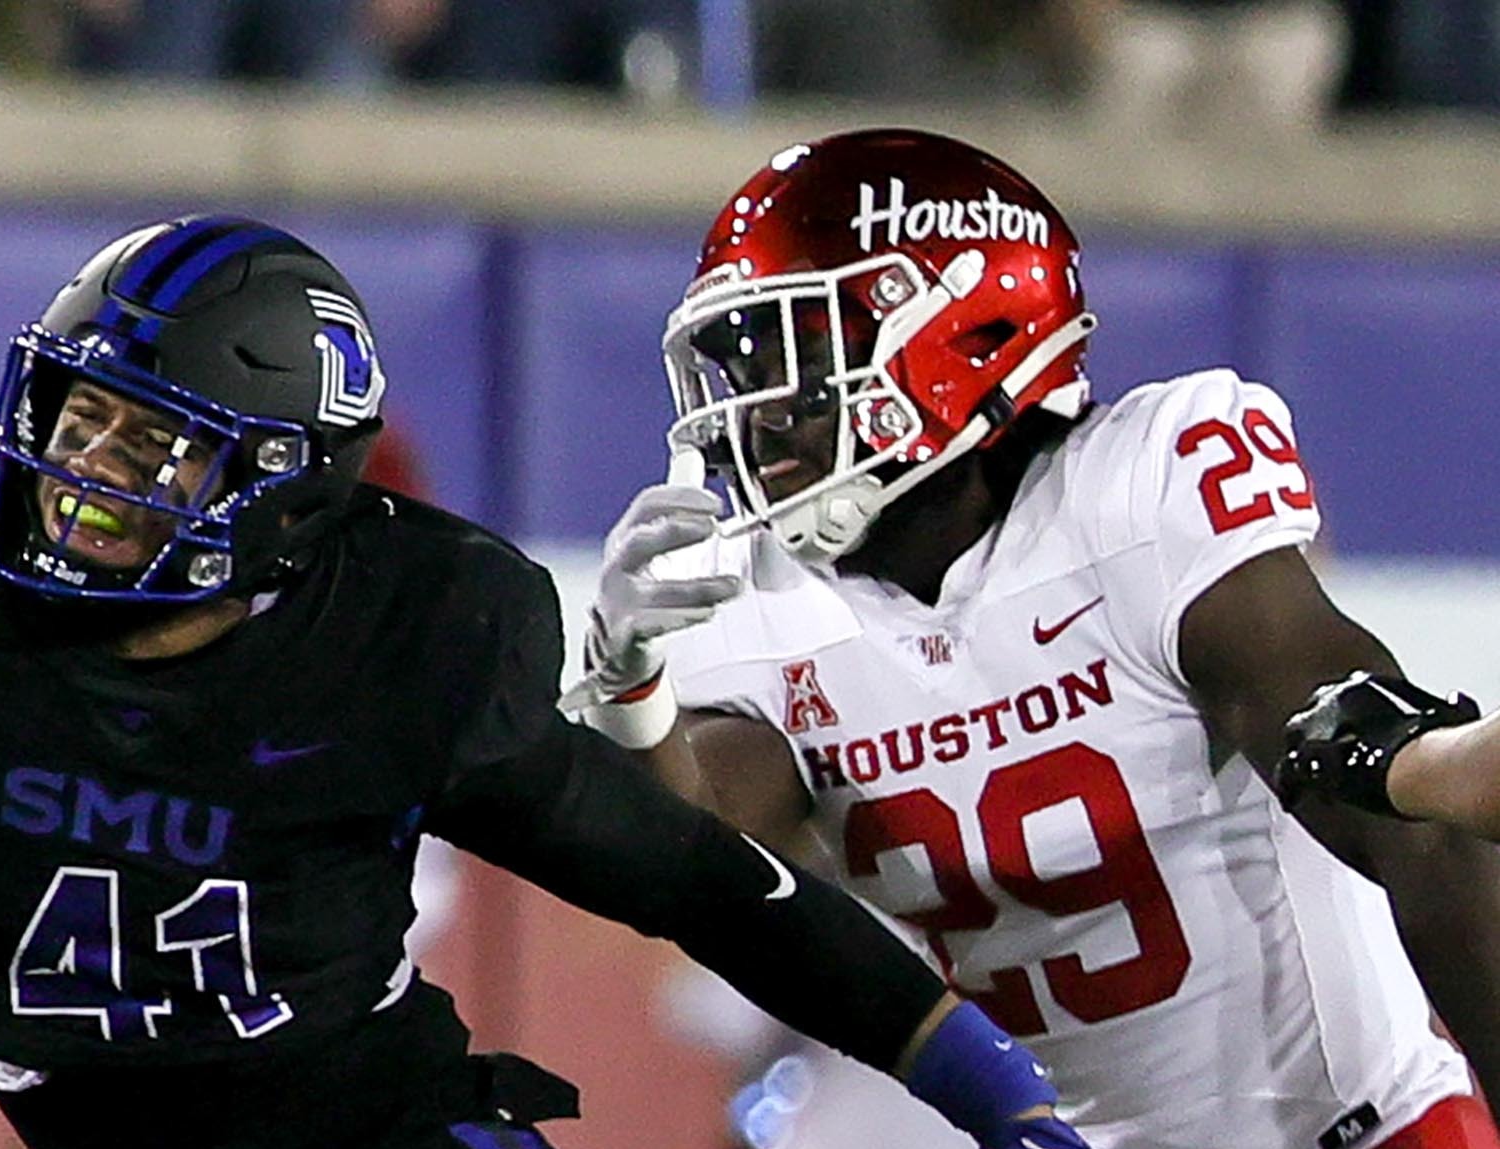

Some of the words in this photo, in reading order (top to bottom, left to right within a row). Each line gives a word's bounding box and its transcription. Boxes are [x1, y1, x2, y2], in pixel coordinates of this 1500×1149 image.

[850, 176, 1049, 252] Houston
[1175, 407, 1314, 536] 29
[802, 658, 1115, 793] HOUSTON
[0, 766, 235, 866] SMU
[8, 866, 295, 1041] 41
[843, 740, 1193, 1037] 29
